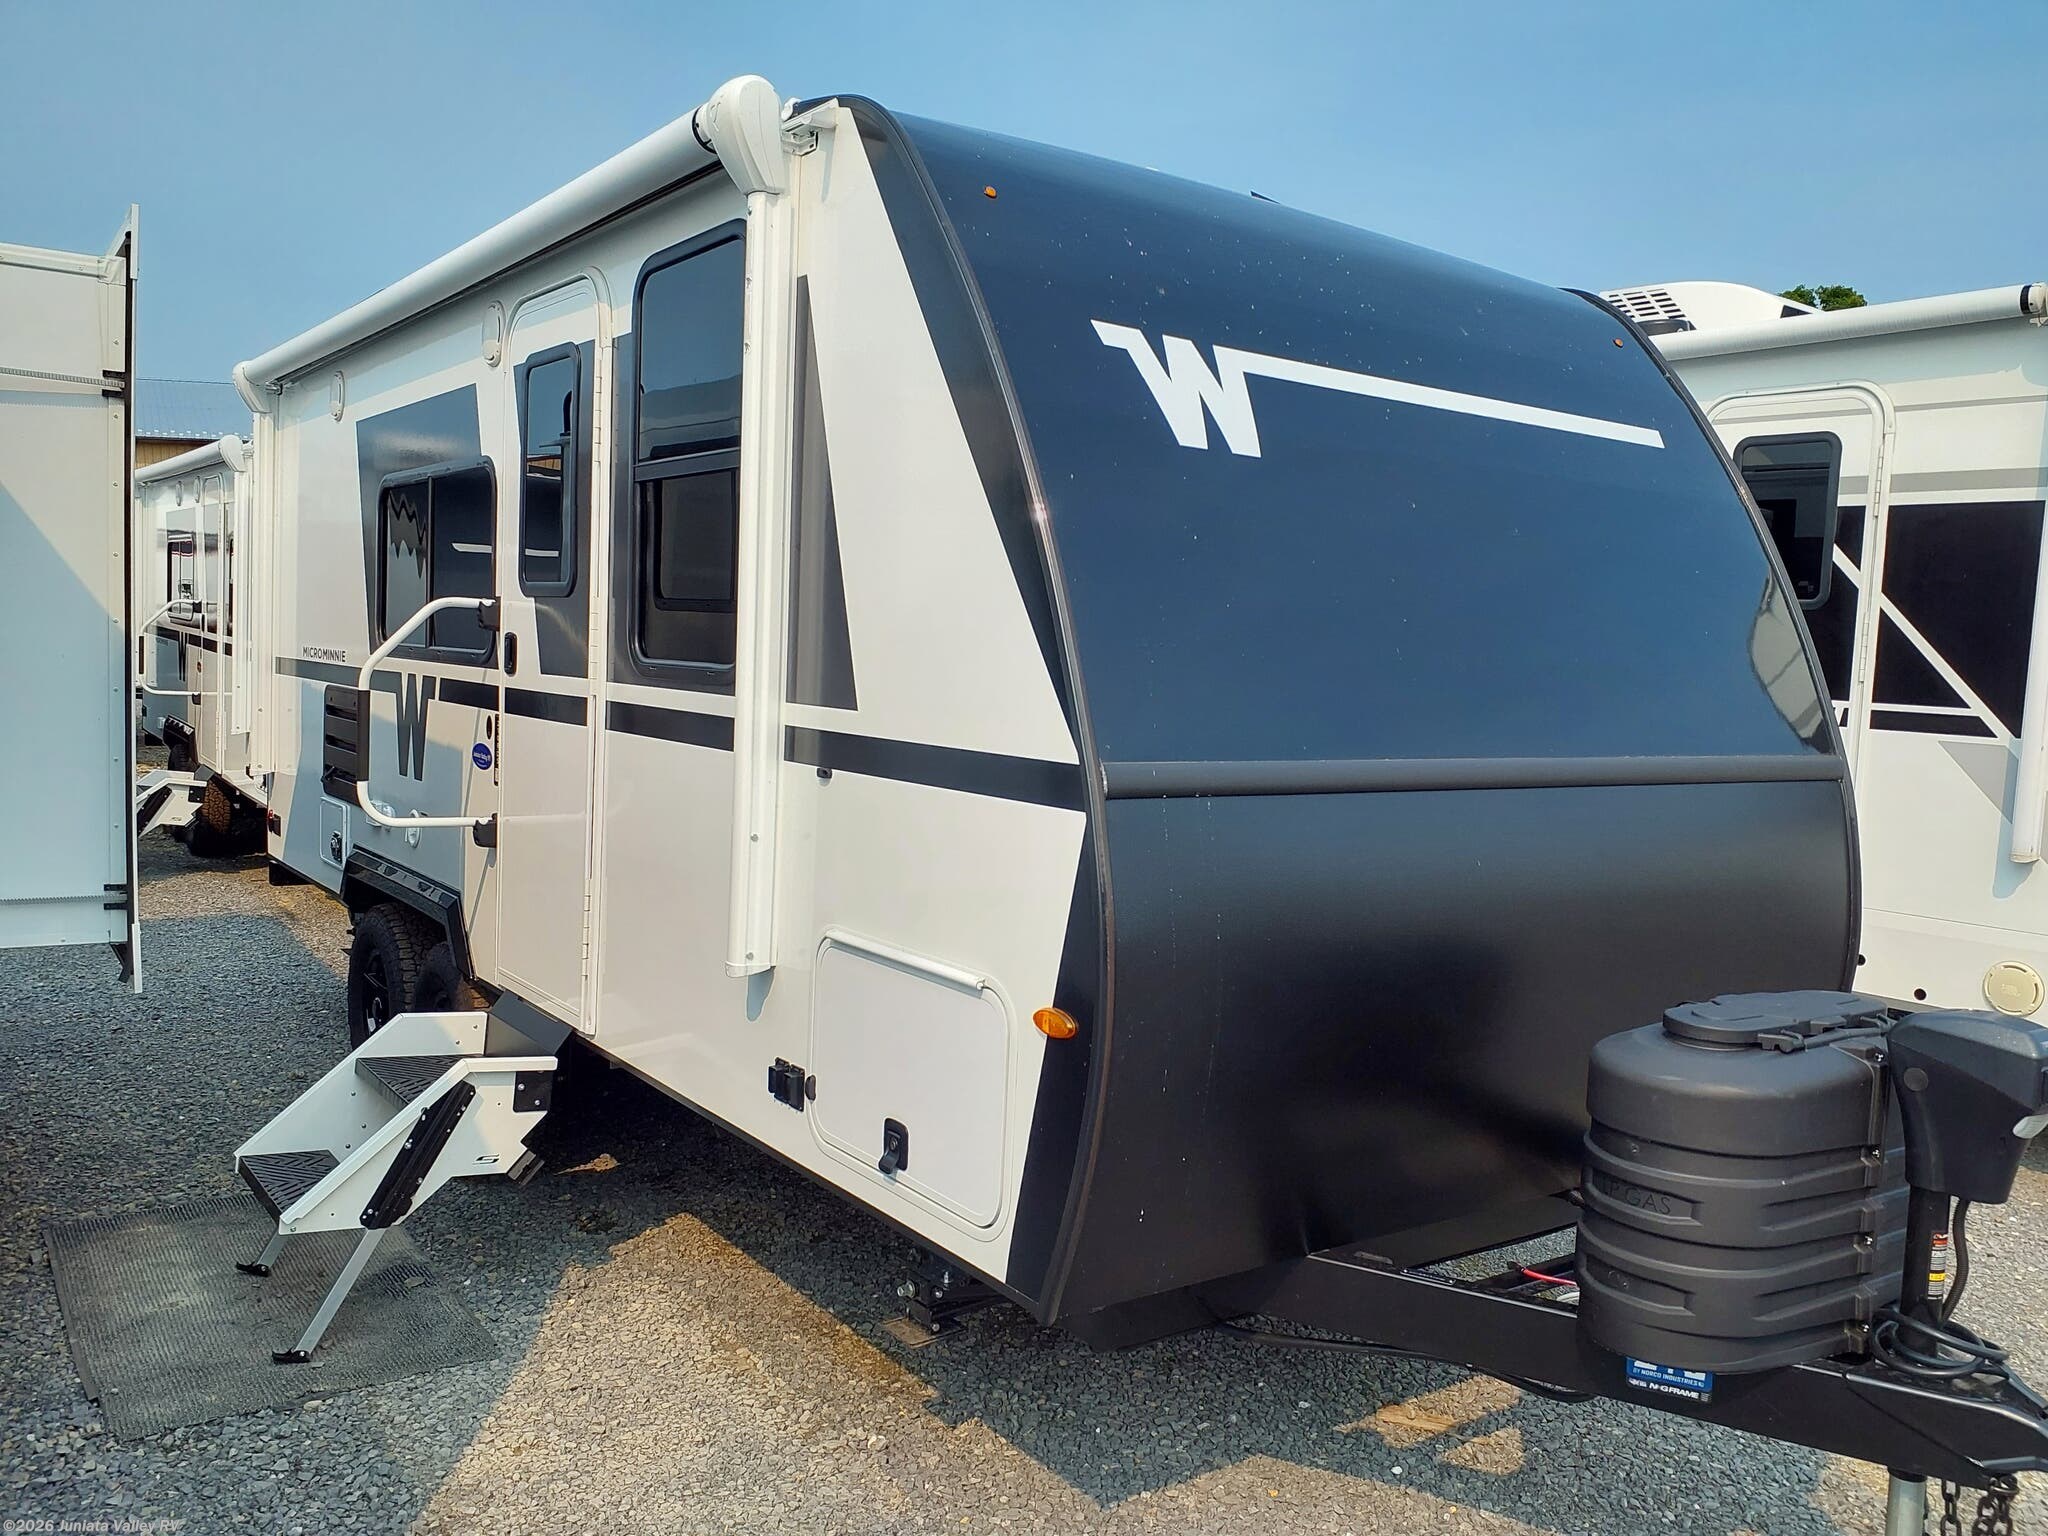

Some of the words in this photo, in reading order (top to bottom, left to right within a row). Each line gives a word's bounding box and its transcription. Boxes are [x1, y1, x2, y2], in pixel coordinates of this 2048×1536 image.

[302, 646, 346, 663] MICROMINNIE
[1624, 1186, 1671, 1215] GAS
[1641, 1368, 1662, 1379] NORCO
[1668, 1386, 1700, 1399] FRAME
